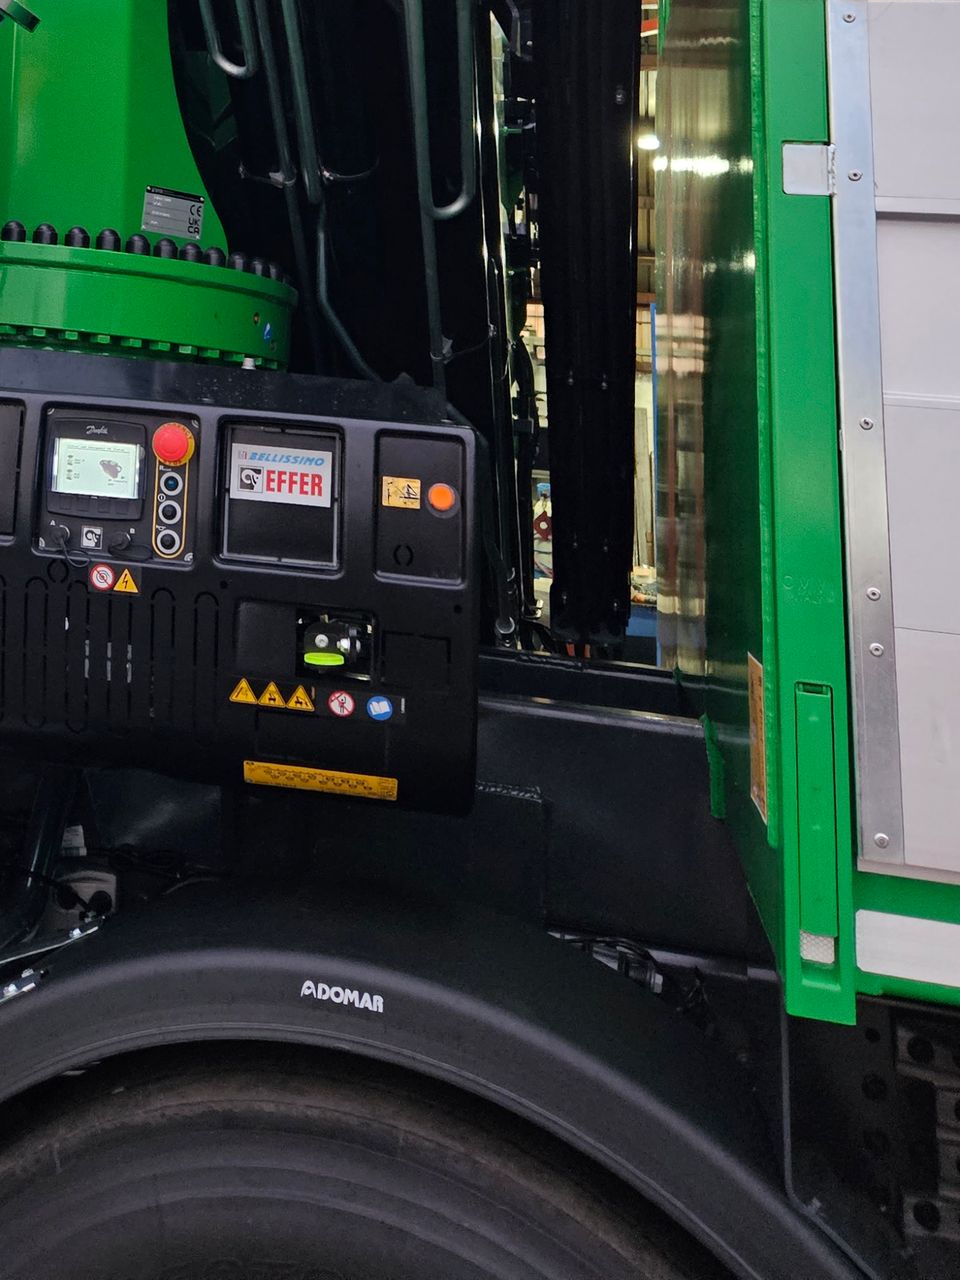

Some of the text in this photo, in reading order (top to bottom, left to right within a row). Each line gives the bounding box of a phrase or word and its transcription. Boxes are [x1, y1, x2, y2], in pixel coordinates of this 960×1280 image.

[249, 451, 325, 467] BELLISSIMO
[265, 469, 324, 497] EFFER
[300, 979, 384, 1013] ADOMAR
